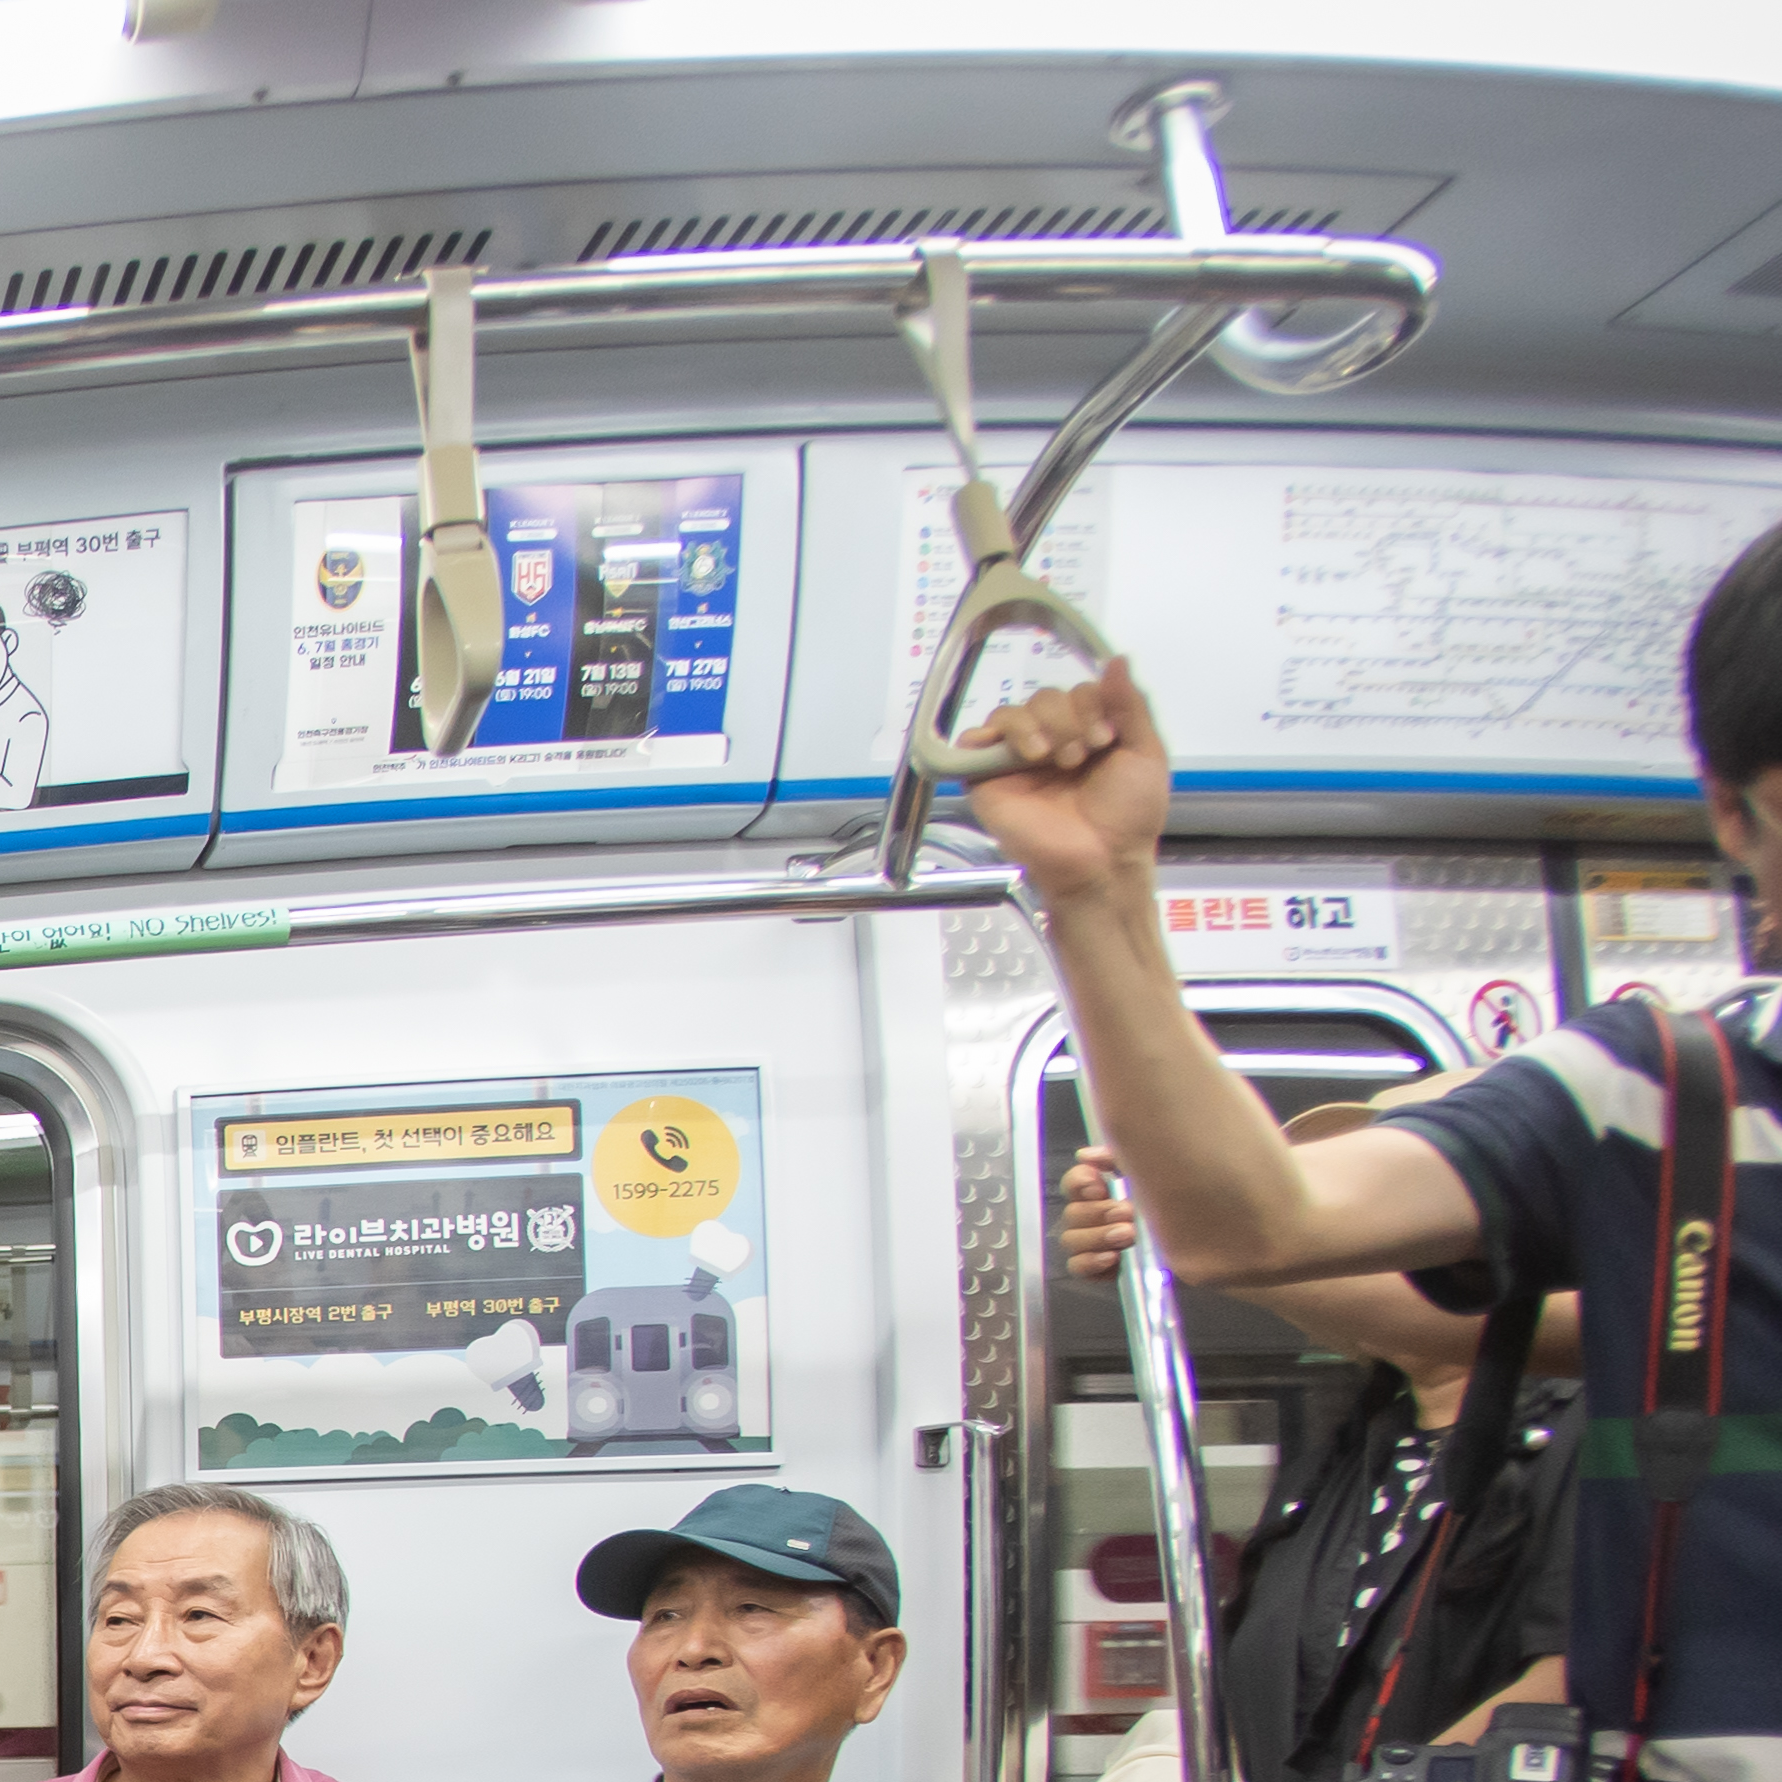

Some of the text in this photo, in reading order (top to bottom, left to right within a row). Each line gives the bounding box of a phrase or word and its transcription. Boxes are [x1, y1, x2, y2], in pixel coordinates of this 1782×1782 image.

[16, 529, 162, 560] 부평역 30번 출구
[293, 620, 385, 640] 인천유나이티드
[315, 640, 336, 654] 7월
[310, 654, 366, 670] 일정 안내
[581, 661, 645, 682] 7월 13일
[666, 657, 729, 677] 7월 27일
[523, 666, 557, 684] 21일
[690, 676, 722, 691] 19:00
[519, 685, 553, 700] 19:00
[604, 681, 638, 695] 19:00
[1167, 896, 1356, 932] 플란트 하고
[41, 922, 111, 949] 없어요!
[129, 918, 165, 939] NO
[175, 908, 278, 936] Shelves!
[276, 1121, 556, 1155] 임플란트, 첫 선택이 중요해요
[612, 1179, 721, 1200] 1599-2275
[294, 1210, 520, 1250] 라이브치과병원
[295, 1243, 451, 1261] LIVE DENTAL HOSPITAL
[1667, 1219, 1715, 1352] Canon
[239, 1303, 394, 1325] 부평시장역 2번 출구
[426, 1296, 561, 1318] 부평역 30번 출구
